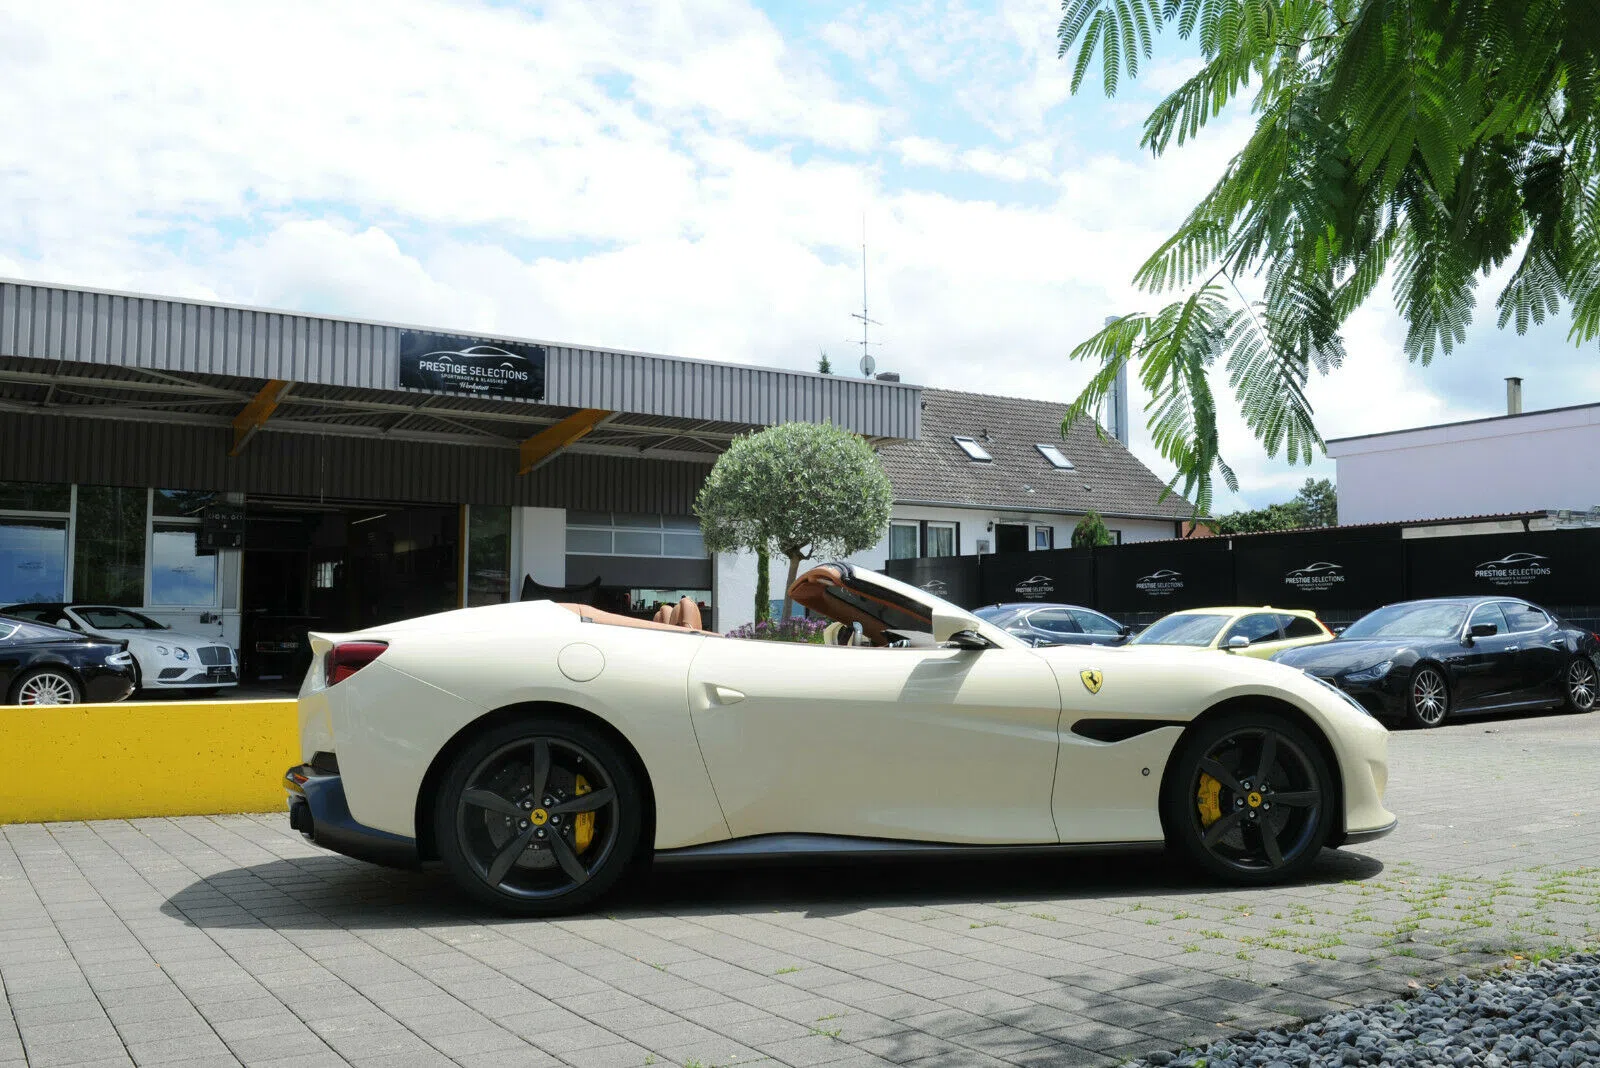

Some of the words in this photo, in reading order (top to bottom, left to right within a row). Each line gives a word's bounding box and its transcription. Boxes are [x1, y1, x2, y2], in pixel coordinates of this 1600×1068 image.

[419, 361, 468, 374] PRESTIGE
[469, 366, 528, 380] SELECTIONS
[441, 373, 474, 381] SPORTWAGEN
[1475, 569, 1507, 577] PRESTIGE
[1508, 567, 1551, 576] SELECTIONS
[1311, 575, 1345, 583] SELECTIONS
